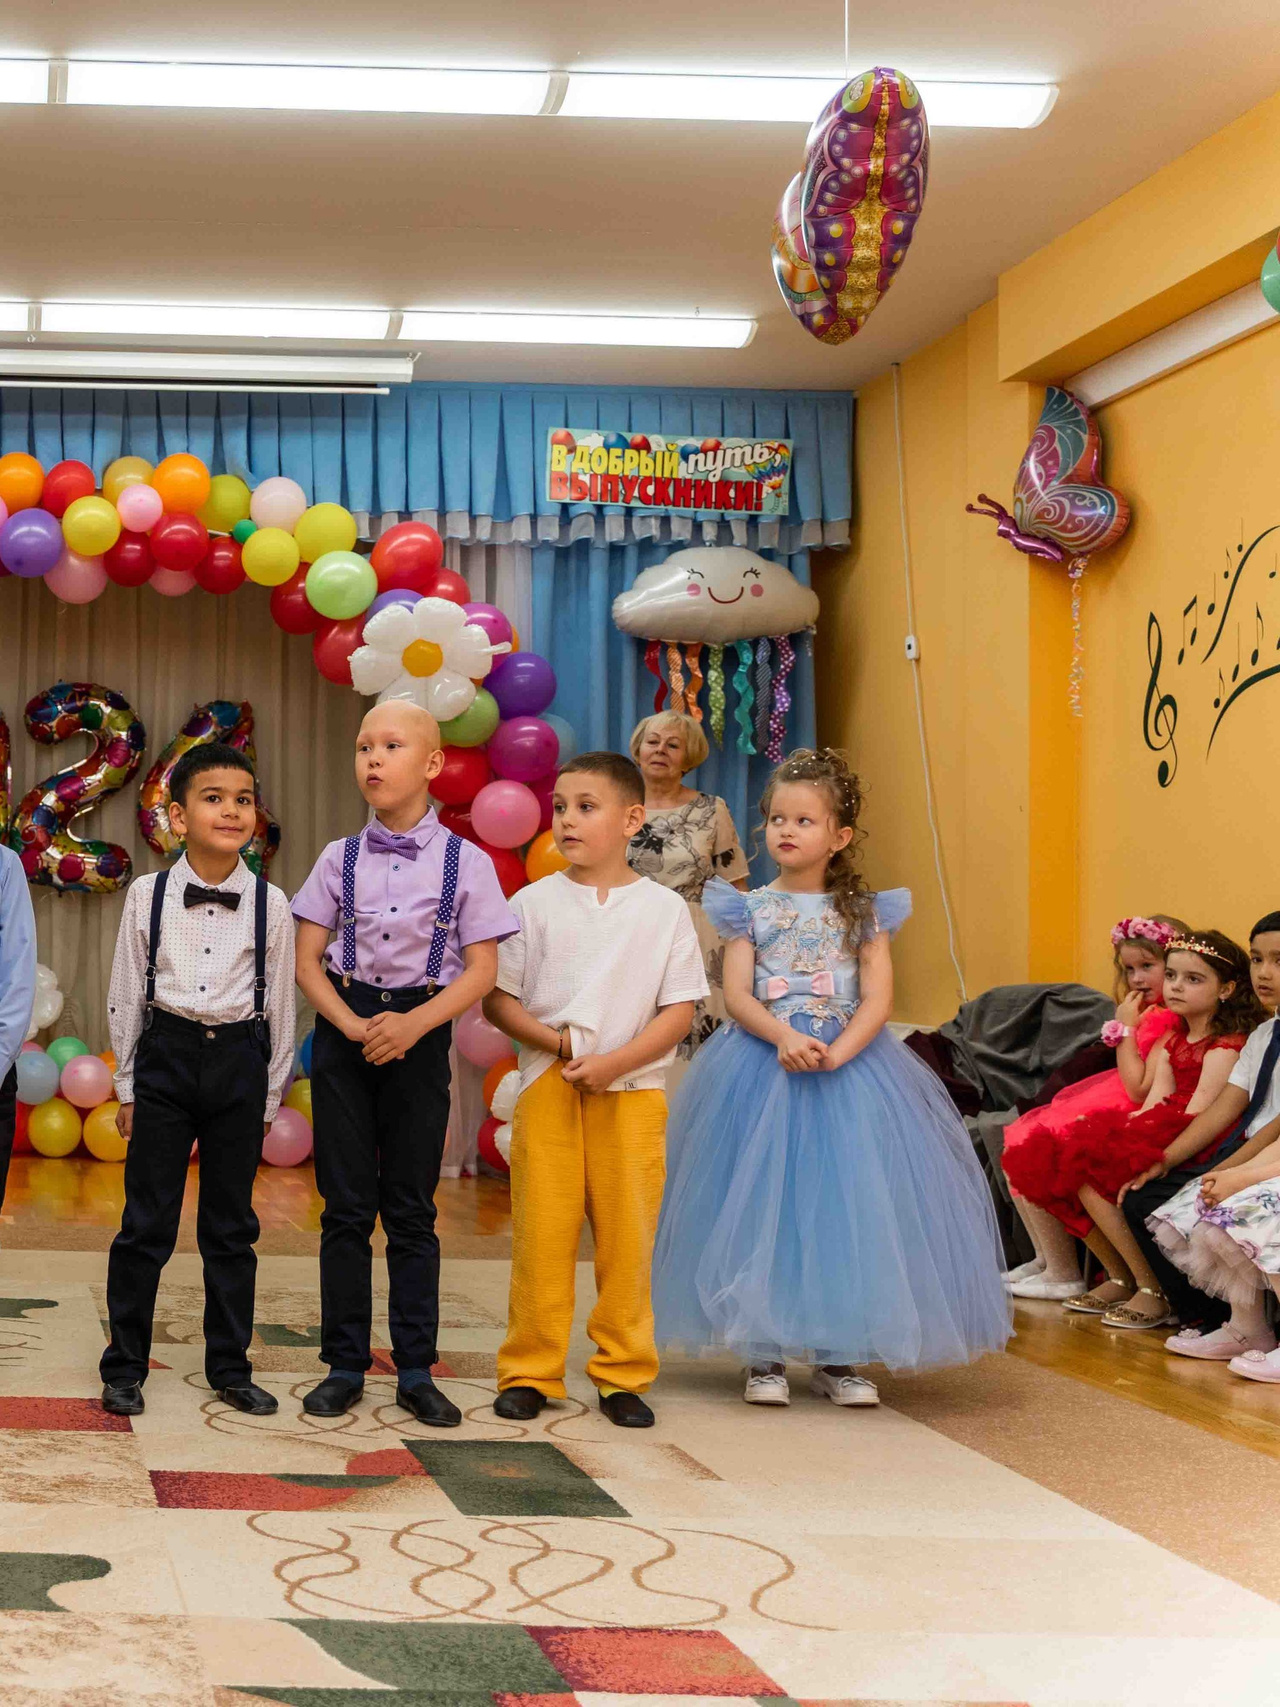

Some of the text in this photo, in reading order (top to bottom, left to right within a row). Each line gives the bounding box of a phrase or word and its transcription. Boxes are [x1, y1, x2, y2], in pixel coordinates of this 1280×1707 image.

[551, 443, 782, 482] В ДОБРЫЙ путь,
[550, 471, 764, 511] ВЫПУСКНИКИ!
